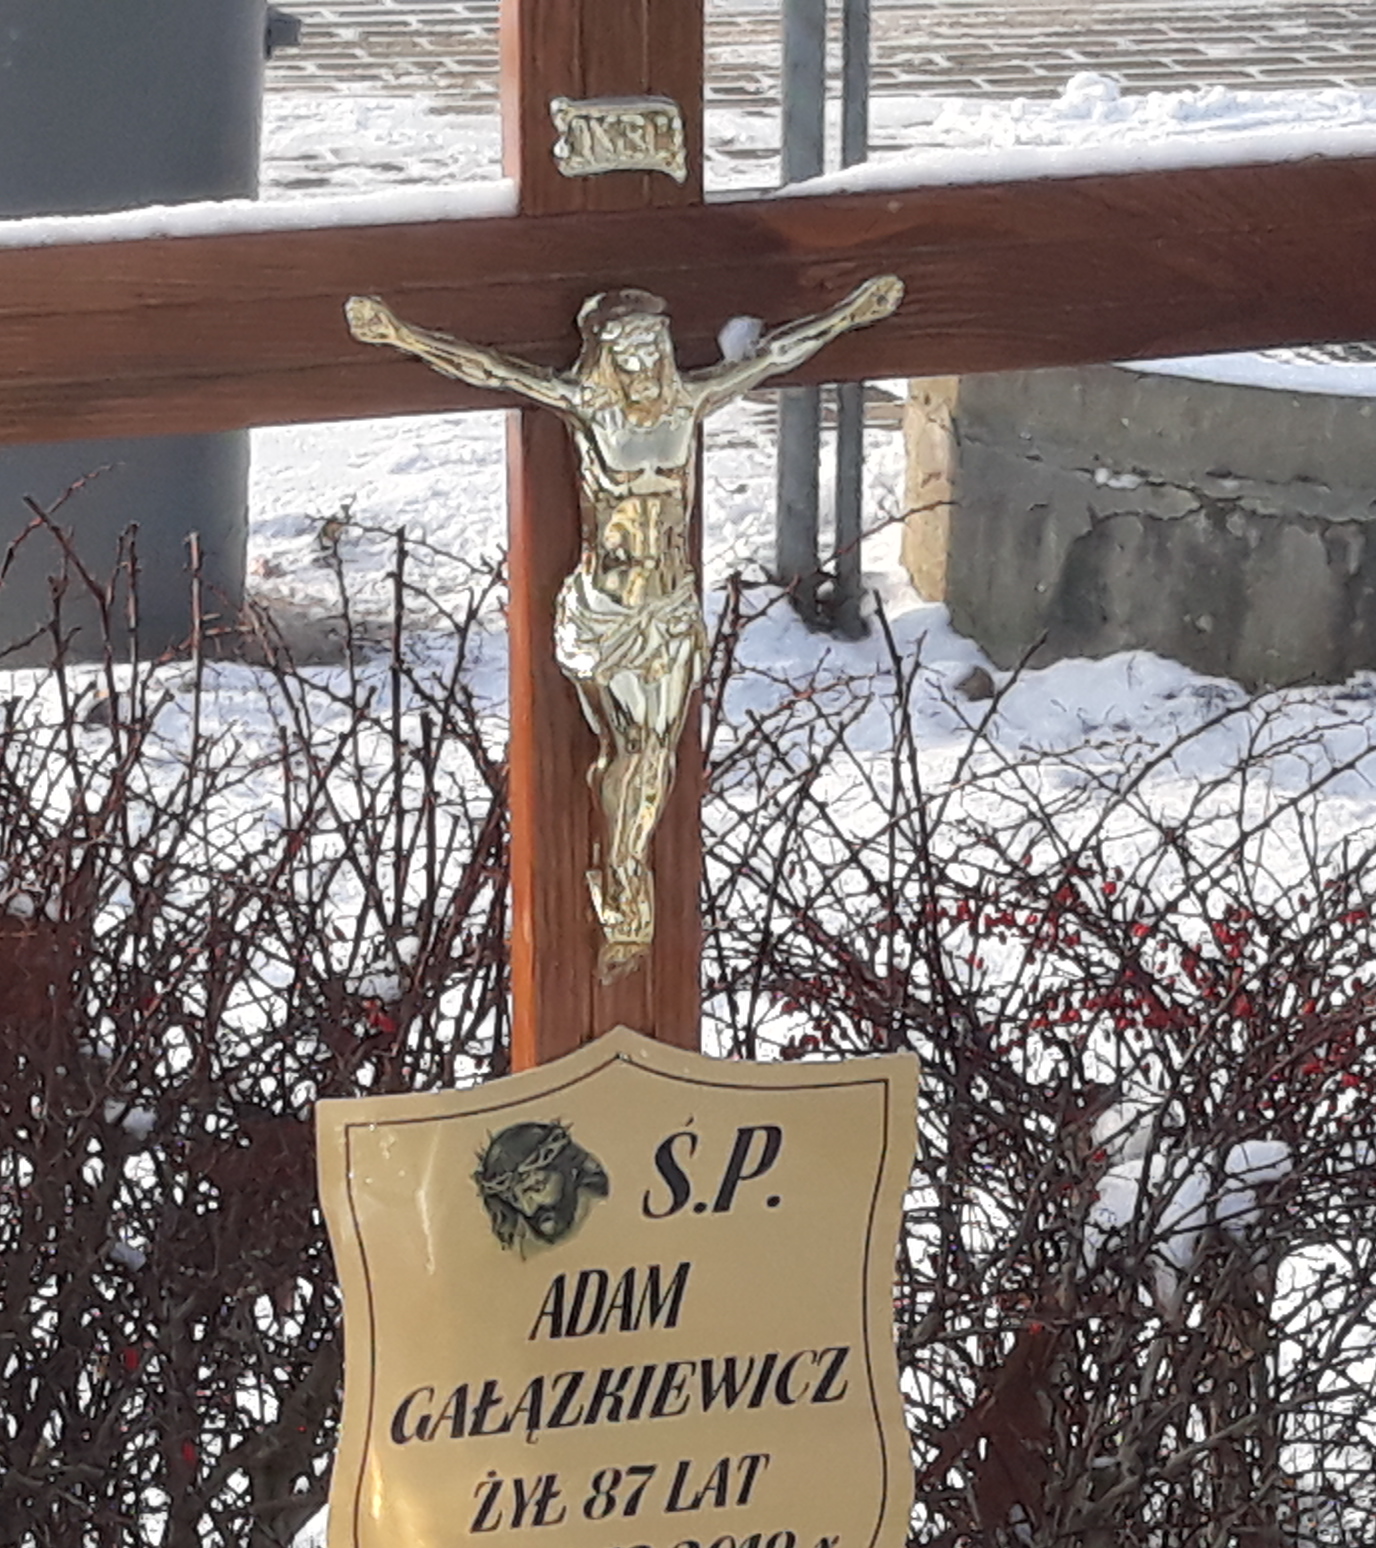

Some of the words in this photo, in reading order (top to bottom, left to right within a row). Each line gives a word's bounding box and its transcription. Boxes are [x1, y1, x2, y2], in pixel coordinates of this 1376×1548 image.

[528, 1261, 692, 1341] ADAM
[389, 1346, 851, 1445] GAŁĄZKIEWICZ
[469, 1470, 569, 1534] ŻYŁ
[582, 1464, 658, 1523] 87
[664, 1453, 771, 1514] LAT
